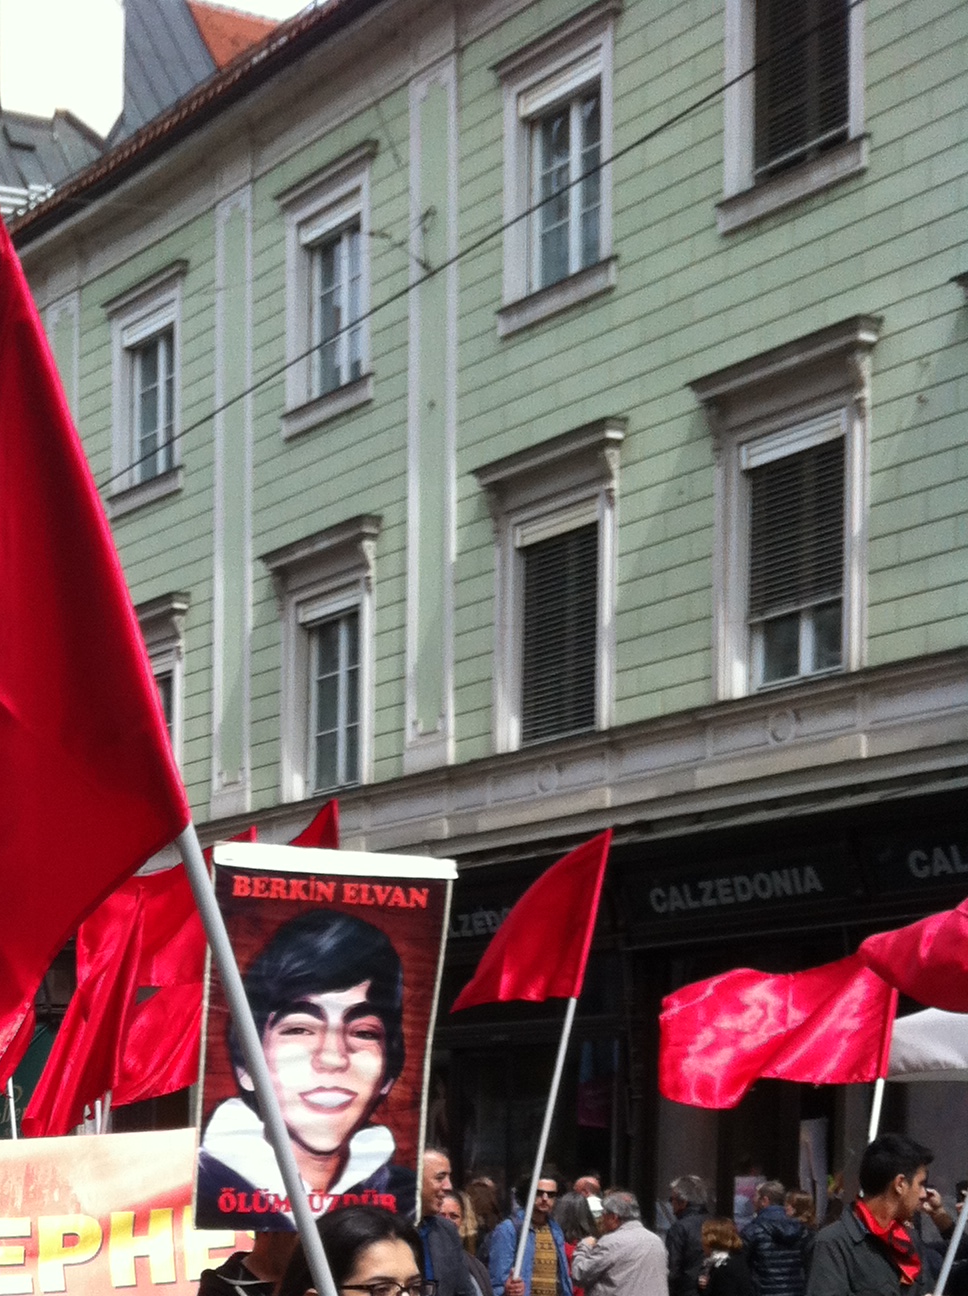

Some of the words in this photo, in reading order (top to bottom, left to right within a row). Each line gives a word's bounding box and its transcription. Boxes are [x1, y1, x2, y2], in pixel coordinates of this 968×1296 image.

[232, 875, 336, 902] BERKİN
[342, 883, 429, 909] ELVAN
[649, 865, 824, 914] CALZEDONIA
